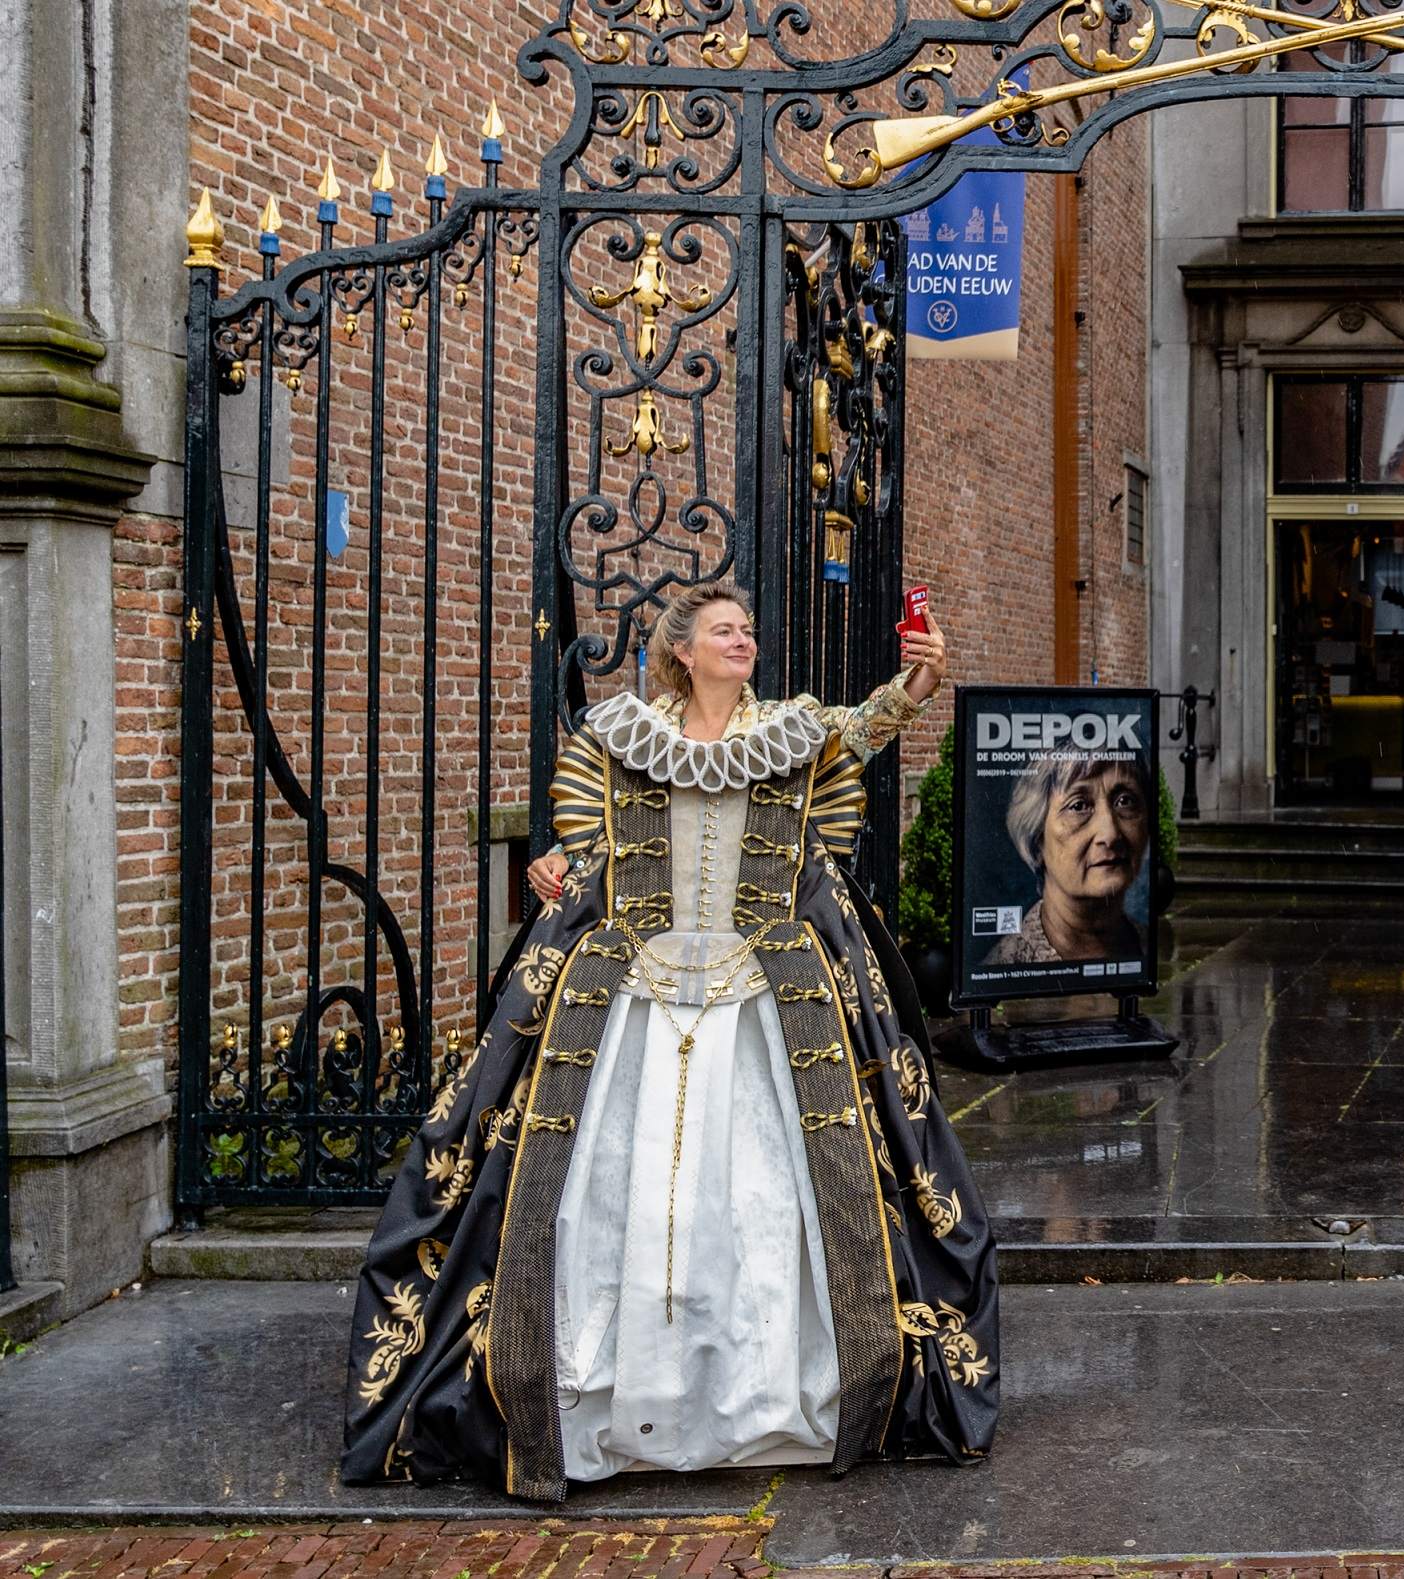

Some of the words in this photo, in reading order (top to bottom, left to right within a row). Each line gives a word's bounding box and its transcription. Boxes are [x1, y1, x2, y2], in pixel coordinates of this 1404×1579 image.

[907, 252, 933, 270] AD
[936, 253, 972, 271] VAN
[975, 254, 998, 272] DE
[907, 276, 957, 294] UDEN
[960, 277, 1013, 295] EEUW
[976, 713, 1142, 750] DEPOK
[976, 752, 989, 762] DE
[991, 752, 1026, 762] DROOM
[1028, 752, 1048, 762] VAN
[1050, 752, 1089, 761] CORNELIS
[1092, 752, 1136, 761] CHASTELEIN
